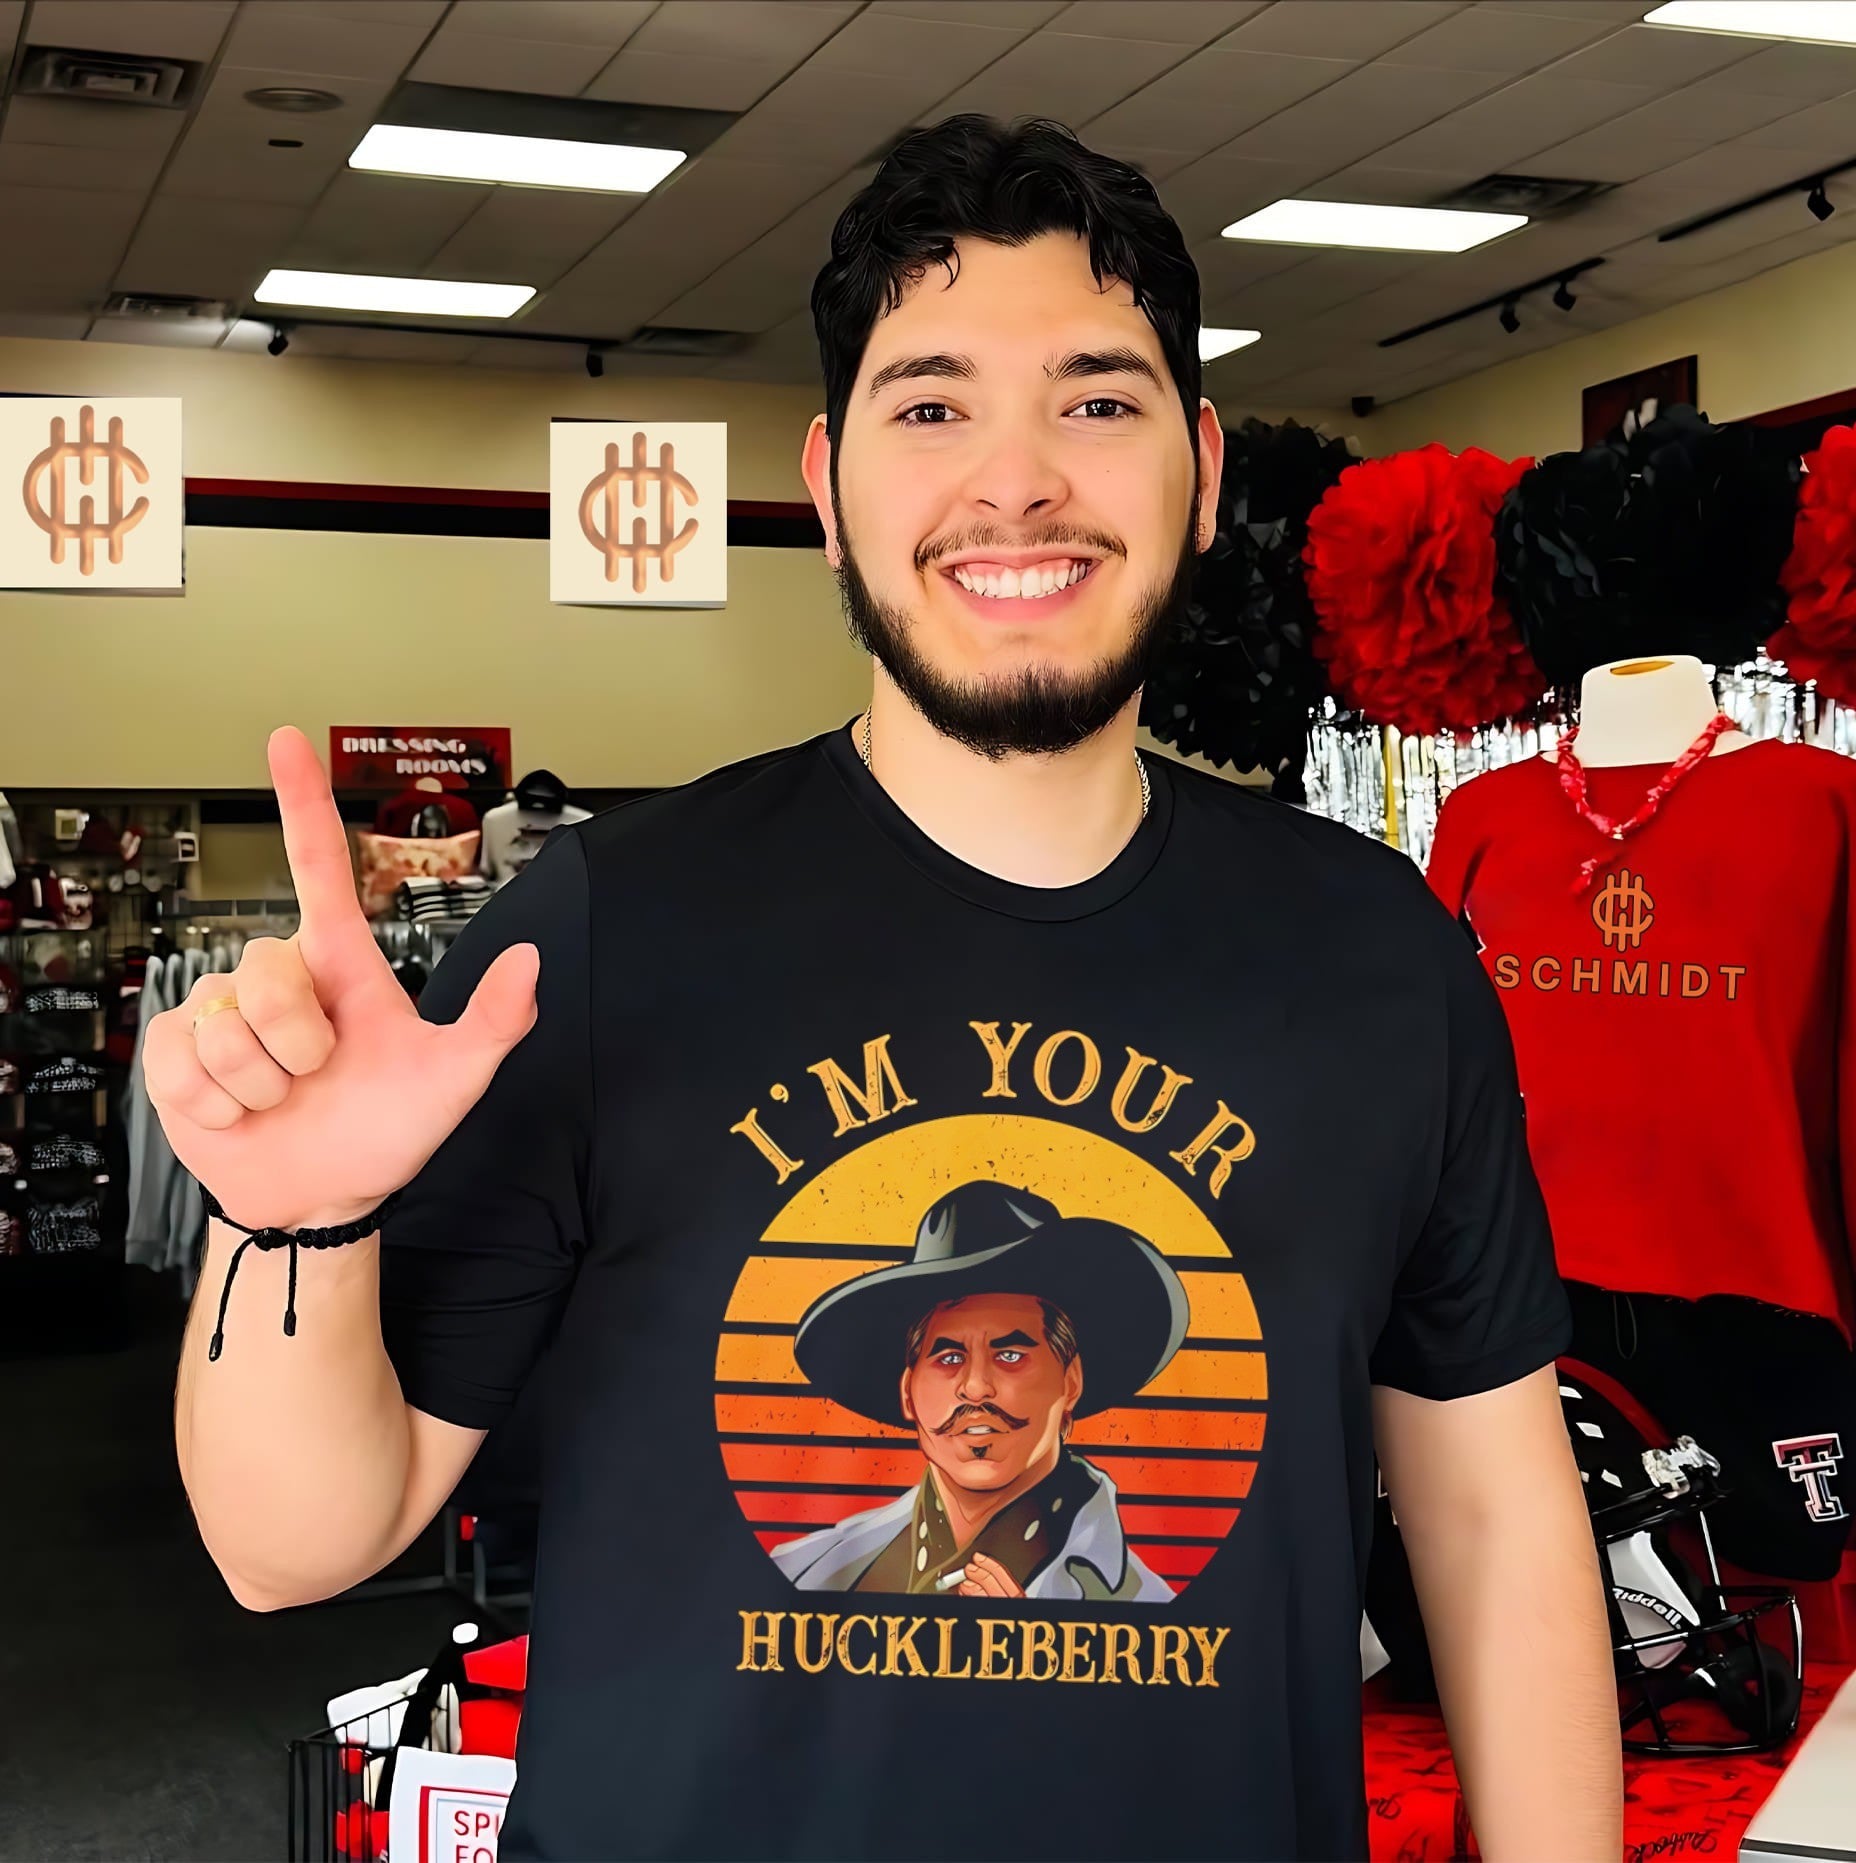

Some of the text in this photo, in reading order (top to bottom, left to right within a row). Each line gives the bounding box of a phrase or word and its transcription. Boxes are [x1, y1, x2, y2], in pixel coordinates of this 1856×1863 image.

[342, 737, 467, 754] DRESSING
[396, 758, 487, 775] ROOMS
[1494, 953, 1747, 1000] SCHMIDT
[730, 1020, 1257, 1200] I'M YOUR
[736, 1610, 1231, 1688] HUCKLEBERRY
